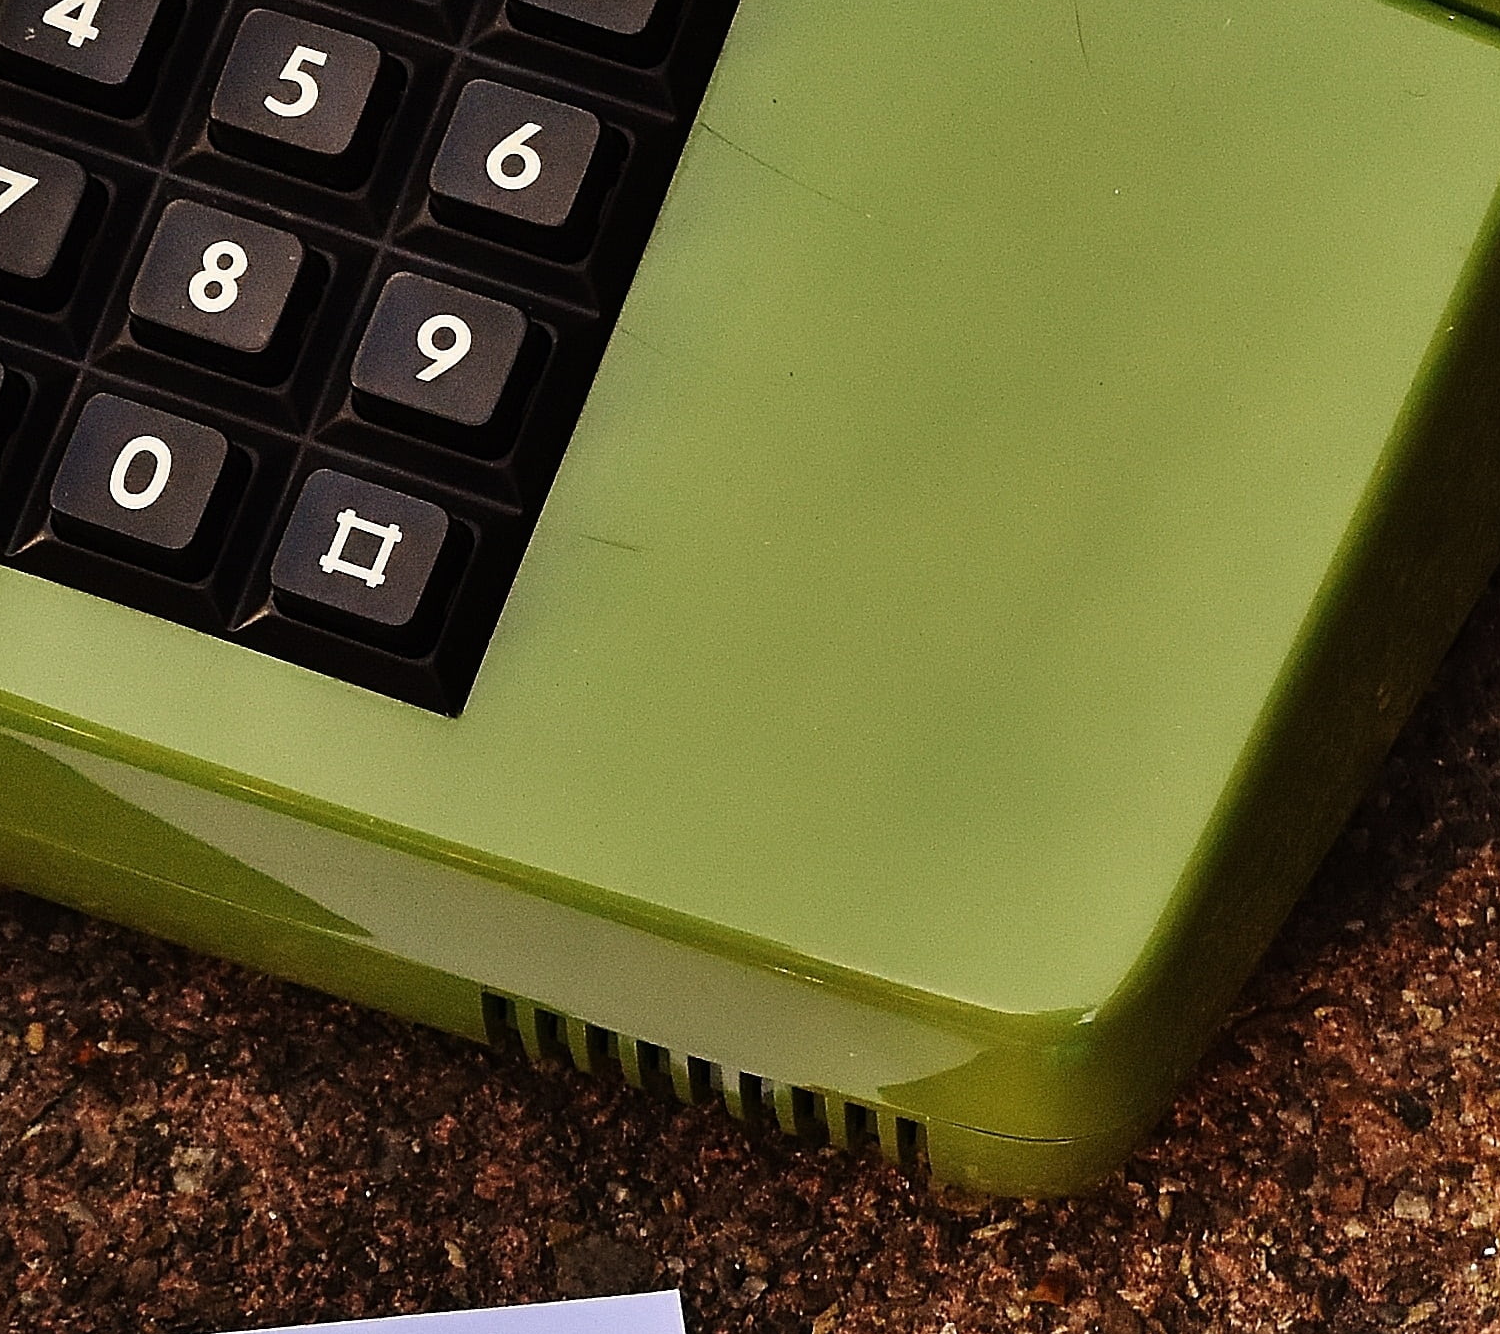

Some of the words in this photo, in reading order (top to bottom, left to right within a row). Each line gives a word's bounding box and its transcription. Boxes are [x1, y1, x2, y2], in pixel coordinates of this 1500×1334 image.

[262, 44, 329, 118] 5
[484, 121, 544, 191] 6
[187, 239, 249, 314] 8
[414, 313, 473, 383] 9
[108, 434, 173, 511] 0
